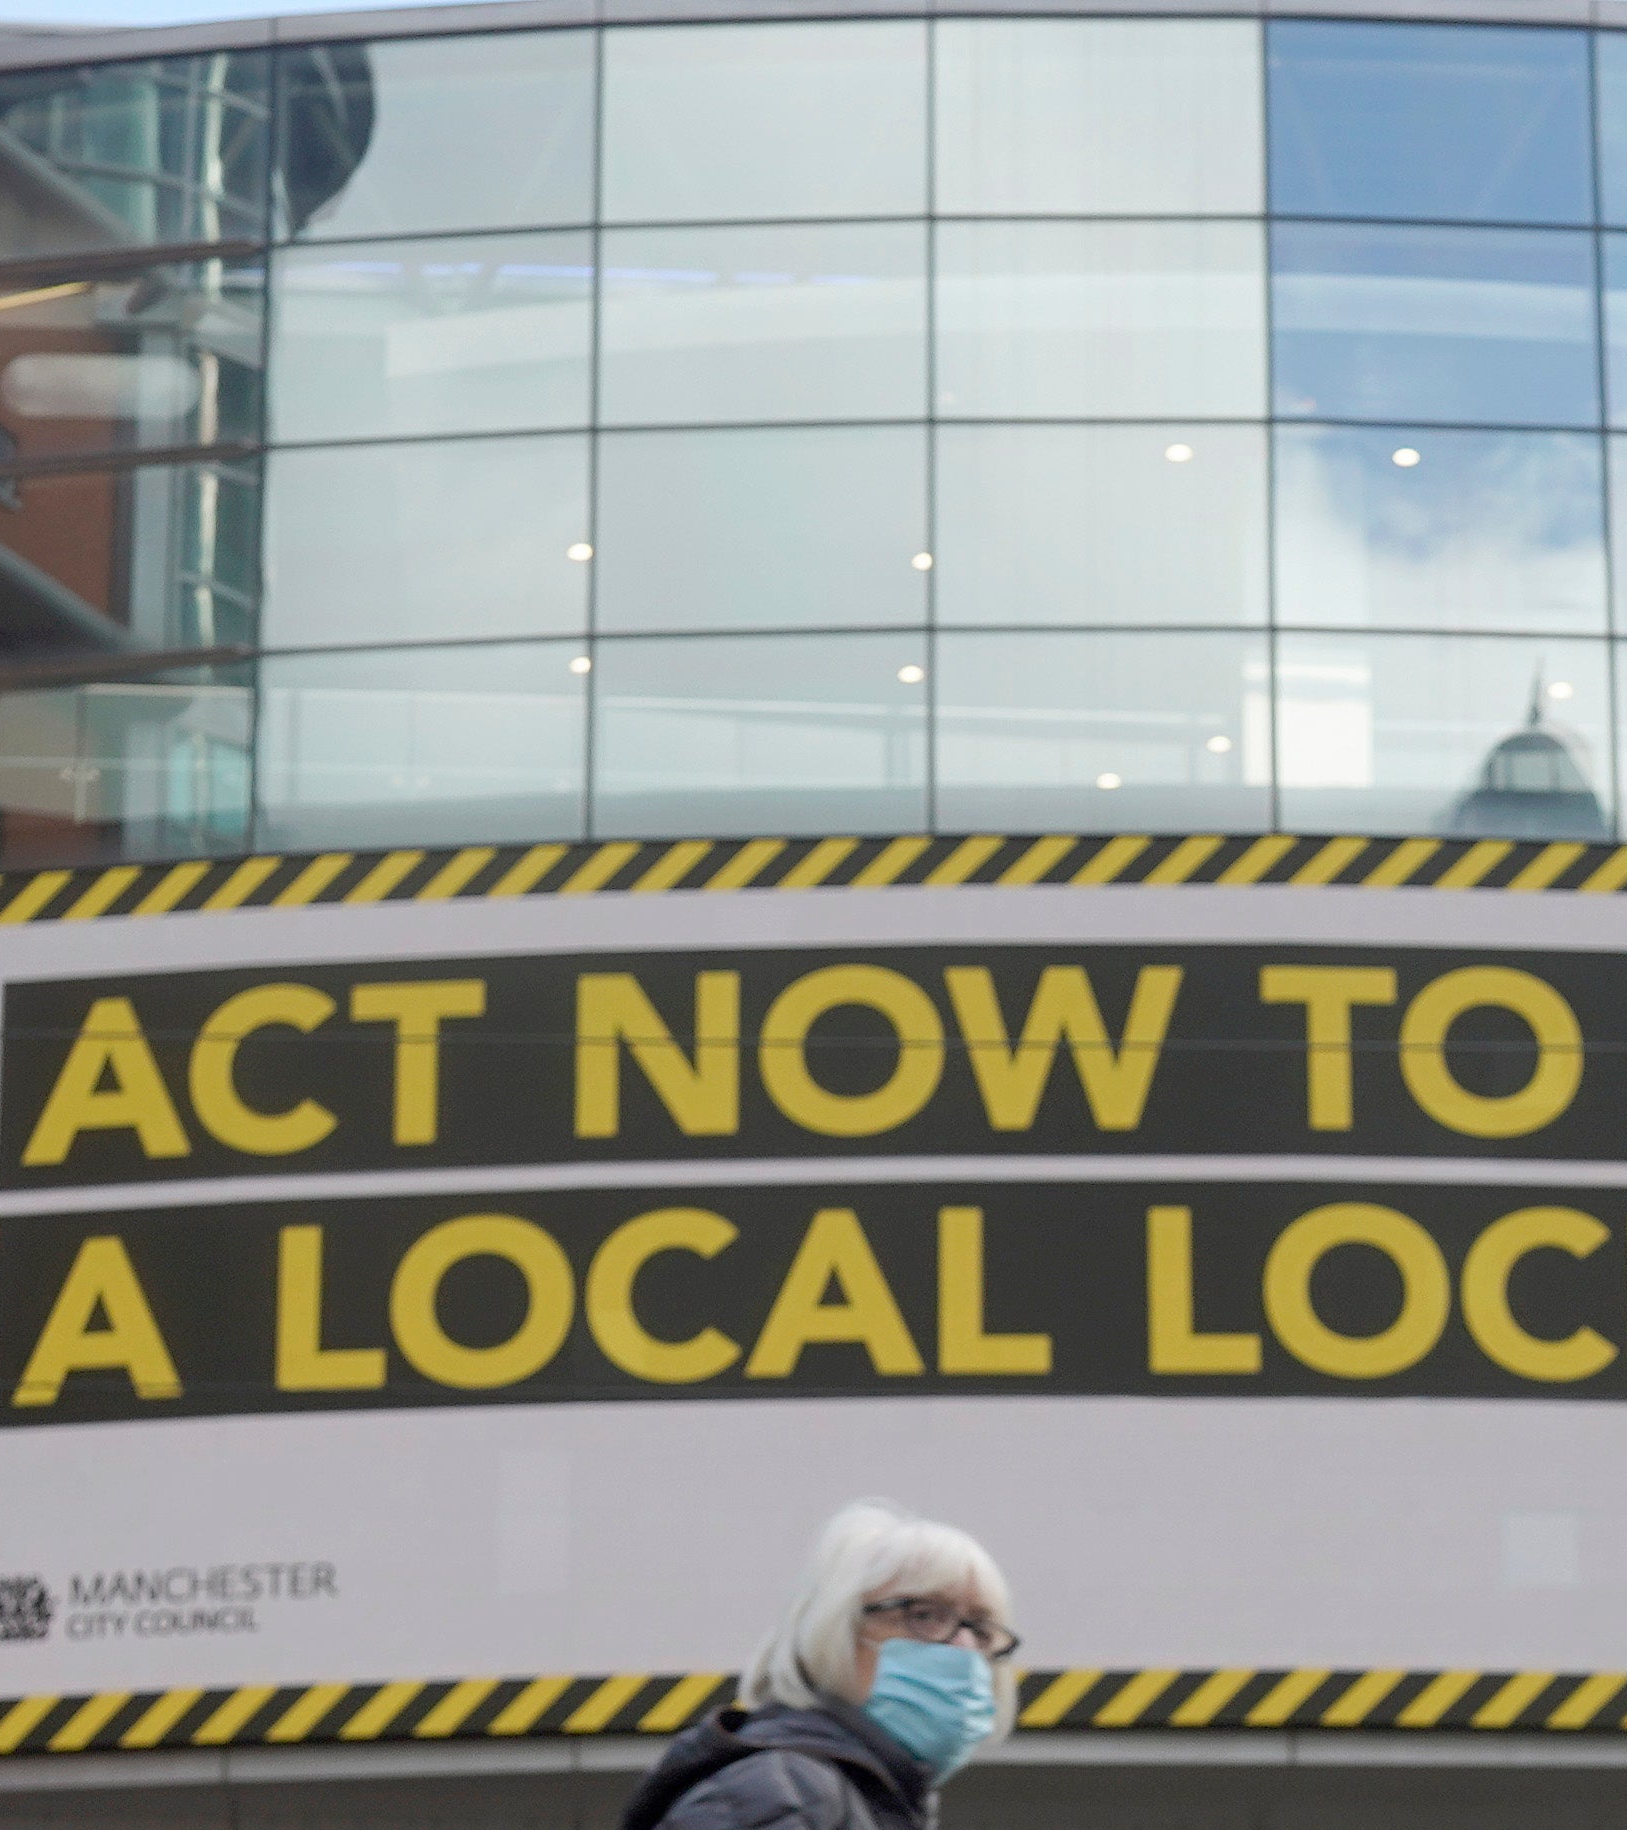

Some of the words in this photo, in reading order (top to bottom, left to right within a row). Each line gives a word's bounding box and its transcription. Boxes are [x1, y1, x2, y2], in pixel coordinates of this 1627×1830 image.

[22, 979, 486, 1167] ACT
[574, 963, 1183, 1139] NOW
[1259, 964, 1584, 1139] TO
[13, 1235, 181, 1407] A
[274, 1206, 1053, 1392] LOCAL
[65, 1611, 127, 1640] CITY
[133, 1606, 259, 1638] COUNCIL
[69, 1561, 338, 1606] MANCHESTER
